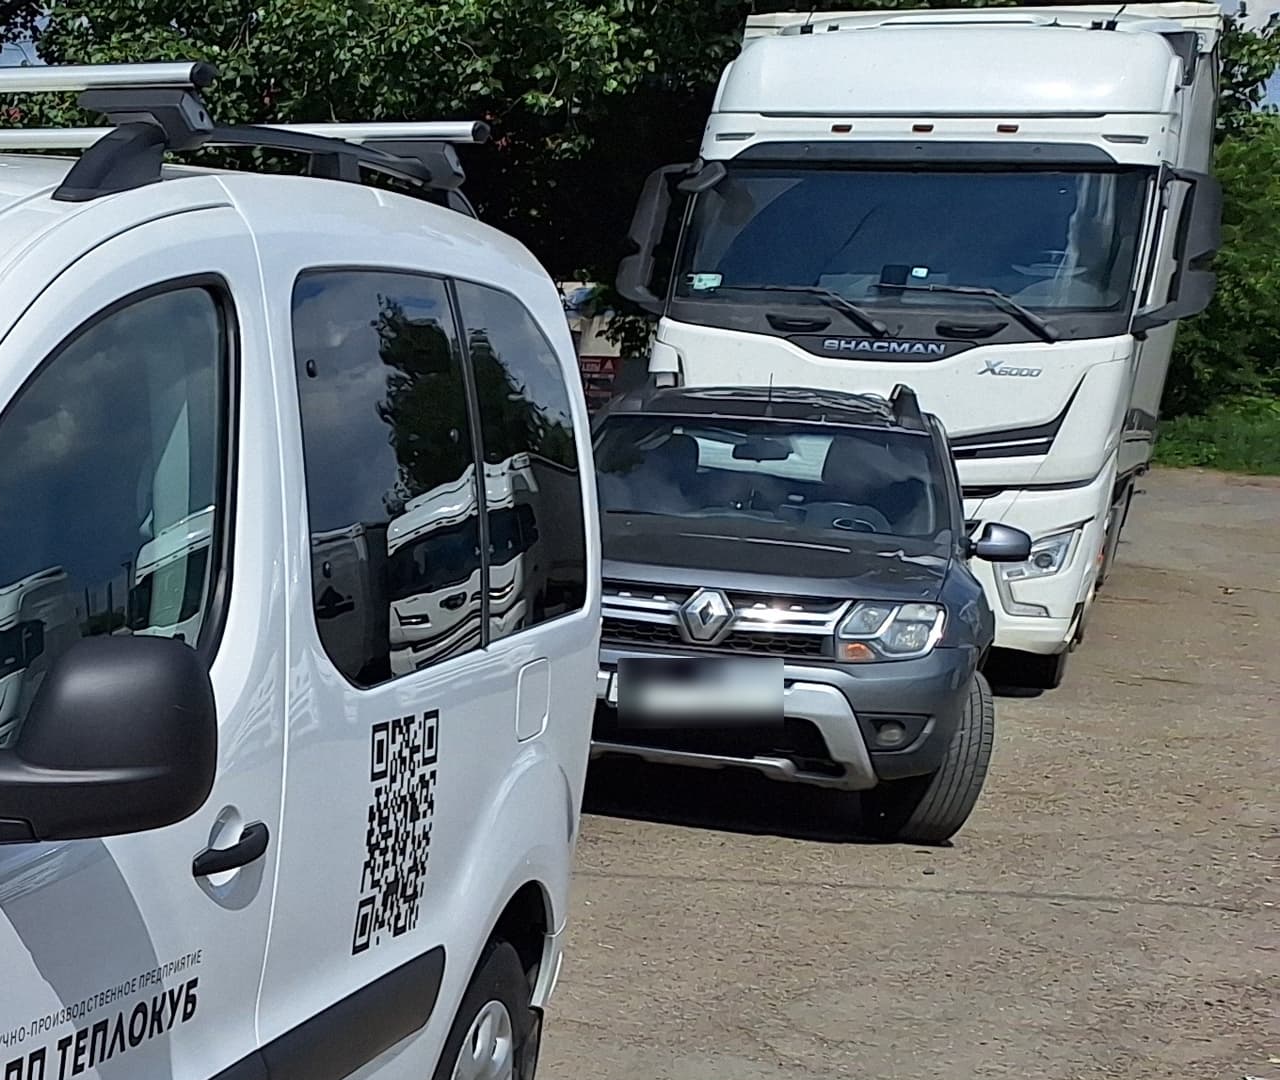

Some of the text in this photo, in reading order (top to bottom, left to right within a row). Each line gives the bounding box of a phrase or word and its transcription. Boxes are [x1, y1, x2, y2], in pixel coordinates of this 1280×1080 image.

[823, 339, 945, 355] SHACMAN
[977, 360, 1042, 378] X6000
[138, 949, 203, 989] ПРЕДПРИЯТИЕ
